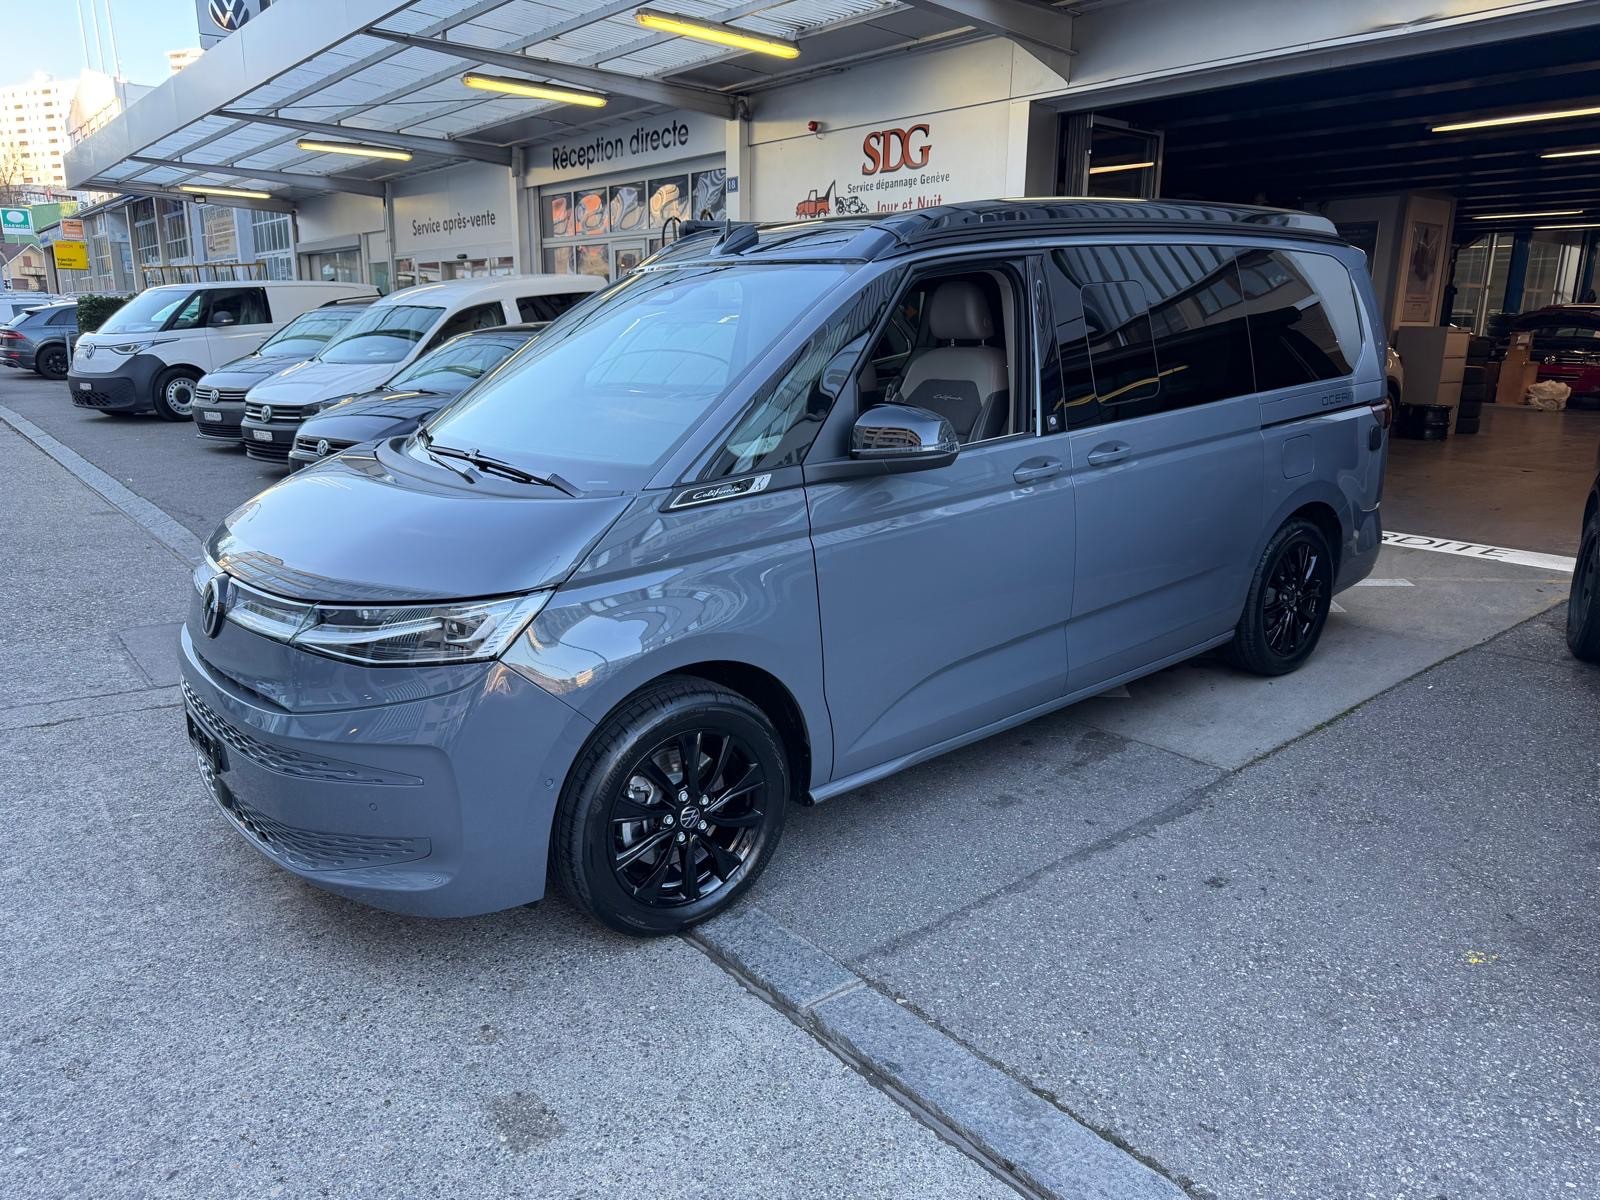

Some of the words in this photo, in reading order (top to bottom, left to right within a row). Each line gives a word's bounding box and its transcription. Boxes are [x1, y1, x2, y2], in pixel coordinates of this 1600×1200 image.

[552, 137, 624, 170] Réception
[629, 120, 689, 155] directe
[862, 123, 932, 176] SDG
[847, 181, 874, 194] Service
[875, 177, 918, 192] dépannage
[920, 172, 950, 185] Genève
[902, 197, 913, 210] et
[917, 194, 942, 208] Nuit
[412, 218, 440, 236] Service
[443, 210, 496, 235] après-vente
[692, 486, 742, 500] California
